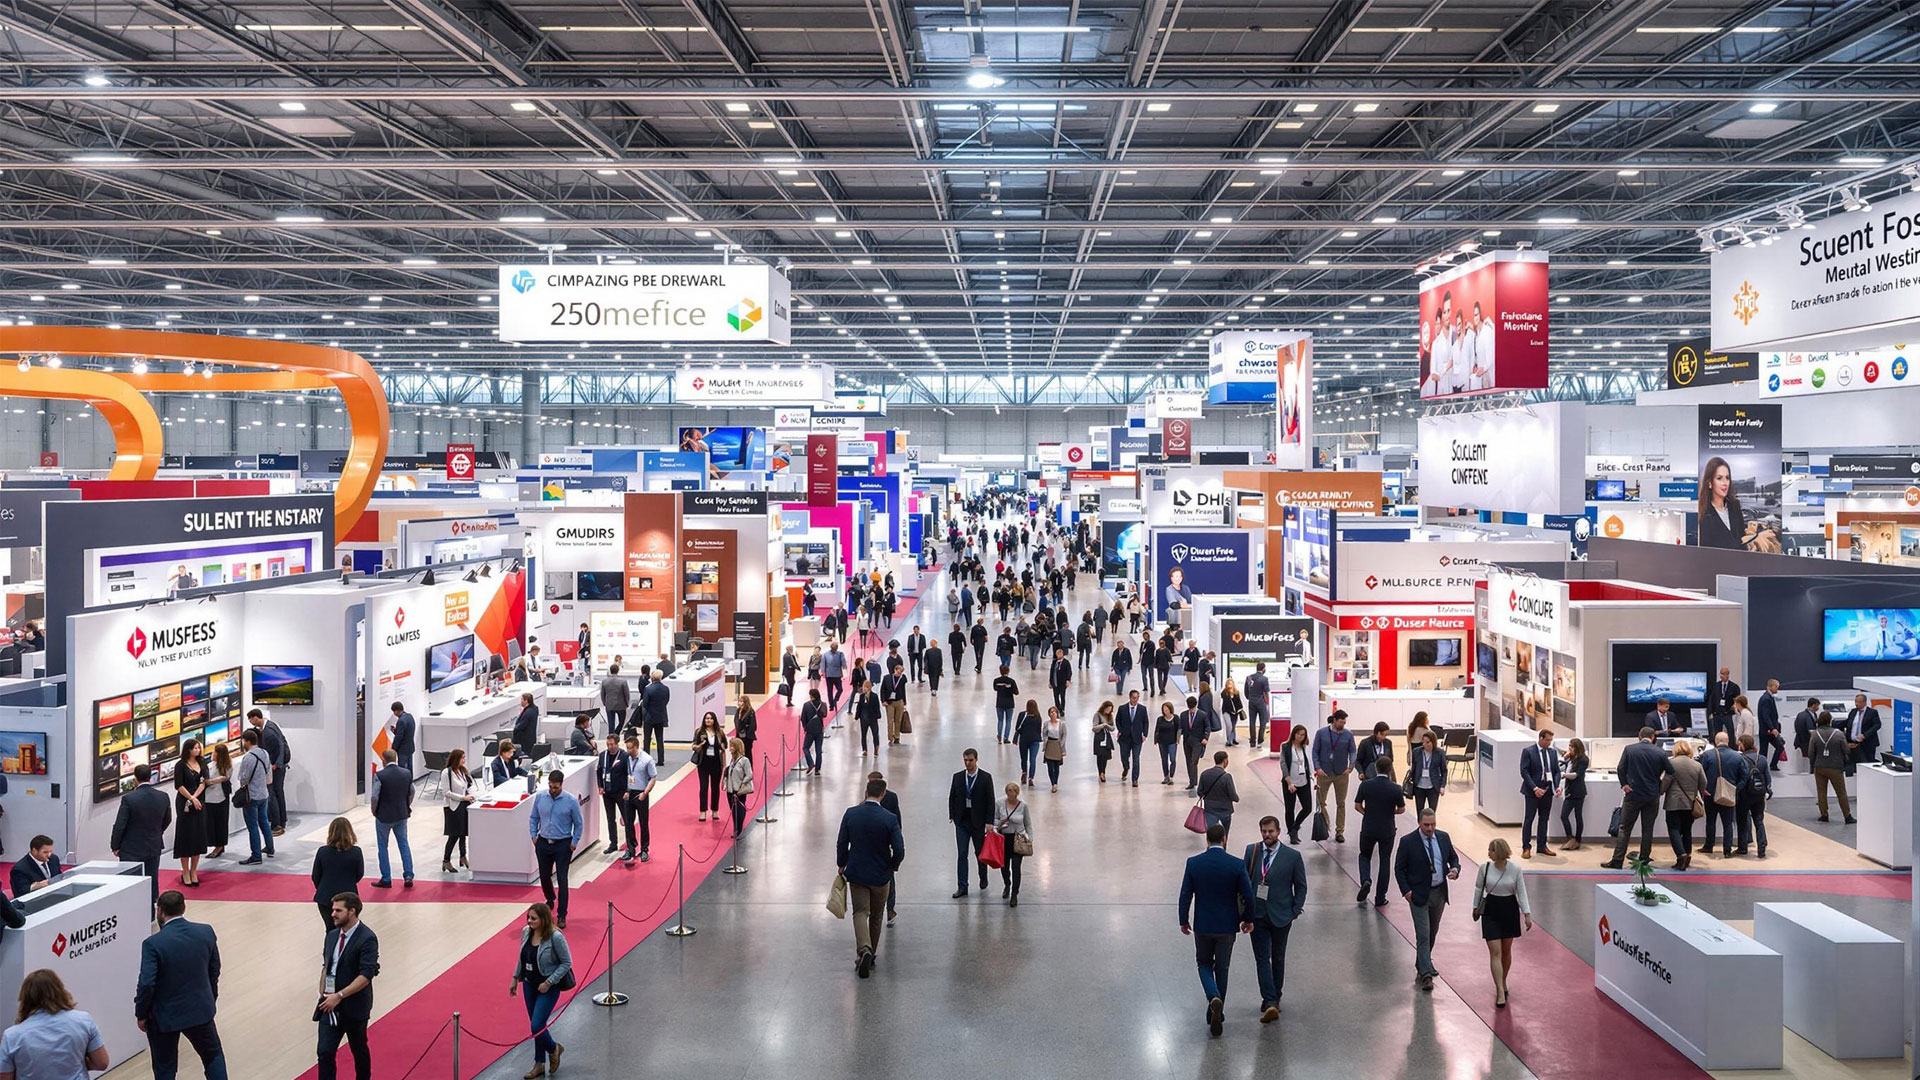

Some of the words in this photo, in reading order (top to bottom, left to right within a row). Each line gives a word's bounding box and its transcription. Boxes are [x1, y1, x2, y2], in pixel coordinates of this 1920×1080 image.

[1800, 222, 1874, 266] Scuent
[633, 275, 657, 287] PBE
[184, 511, 244, 533] SULENT
[246, 510, 272, 528] THE
[275, 507, 324, 527] NSTARY
[556, 527, 615, 539] GMUDIRS
[152, 621, 216, 651] MUSFESS
